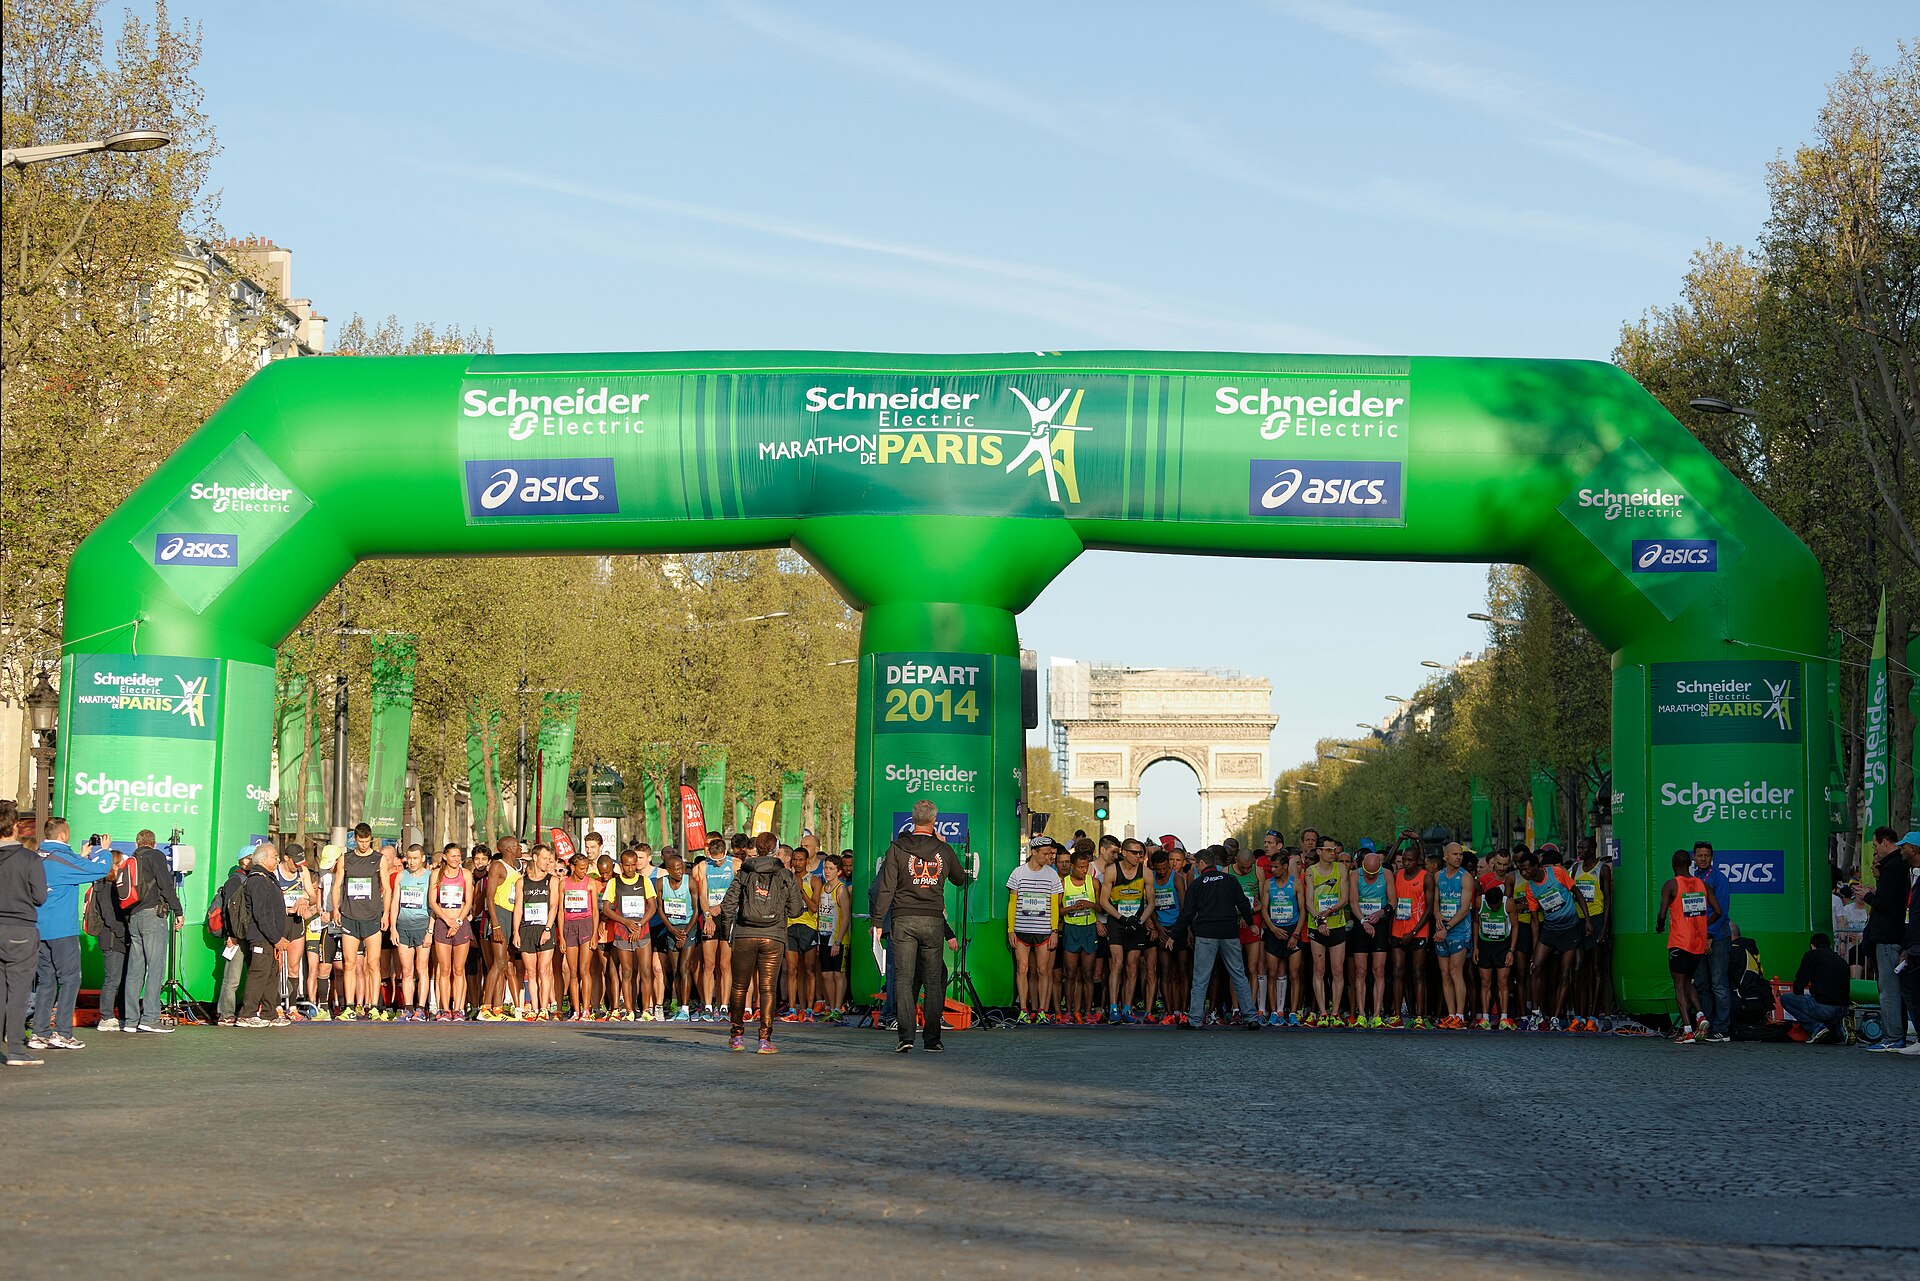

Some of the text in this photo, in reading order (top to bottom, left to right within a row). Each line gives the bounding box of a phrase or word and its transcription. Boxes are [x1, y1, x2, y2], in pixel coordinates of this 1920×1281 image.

[463, 387, 650, 417] Schneider
[805, 386, 980, 412] Schneider
[1215, 386, 1405, 417] Schneider
[543, 416, 645, 436] Electric
[879, 411, 975, 428] Electric
[1295, 417, 1398, 438] Electric
[758, 433, 1004, 466] MARATHON DE PARIS
[189, 481, 293, 502] Schneider
[519, 475, 600, 503] asics
[1301, 478, 1385, 505] asics
[1578, 487, 1685, 507] Schneider
[231, 501, 290, 513] Electric
[1624, 506, 1683, 518] Electric
[182, 542, 229, 559] asics
[1661, 549, 1708, 564] asics
[93, 672, 164, 687] Schneider
[886, 661, 980, 686] DÉPART
[119, 686, 161, 695] Electric
[1676, 679, 1752, 694] Schneider
[78, 695, 120, 704] MARATHON
[119, 696, 173, 712] PARIS
[885, 688, 980, 723] 2014
[1708, 692, 1751, 701] Electric
[1658, 703, 1709, 714] MARATHON
[1708, 702, 1763, 717] PARIS
[885, 764, 978, 782] Schneider
[74, 772, 203, 800] Schneider
[923, 781, 975, 793] Electric
[1660, 780, 1794, 806] Schneider
[122, 797, 199, 815] Electric
[1719, 805, 1792, 820] Electric
